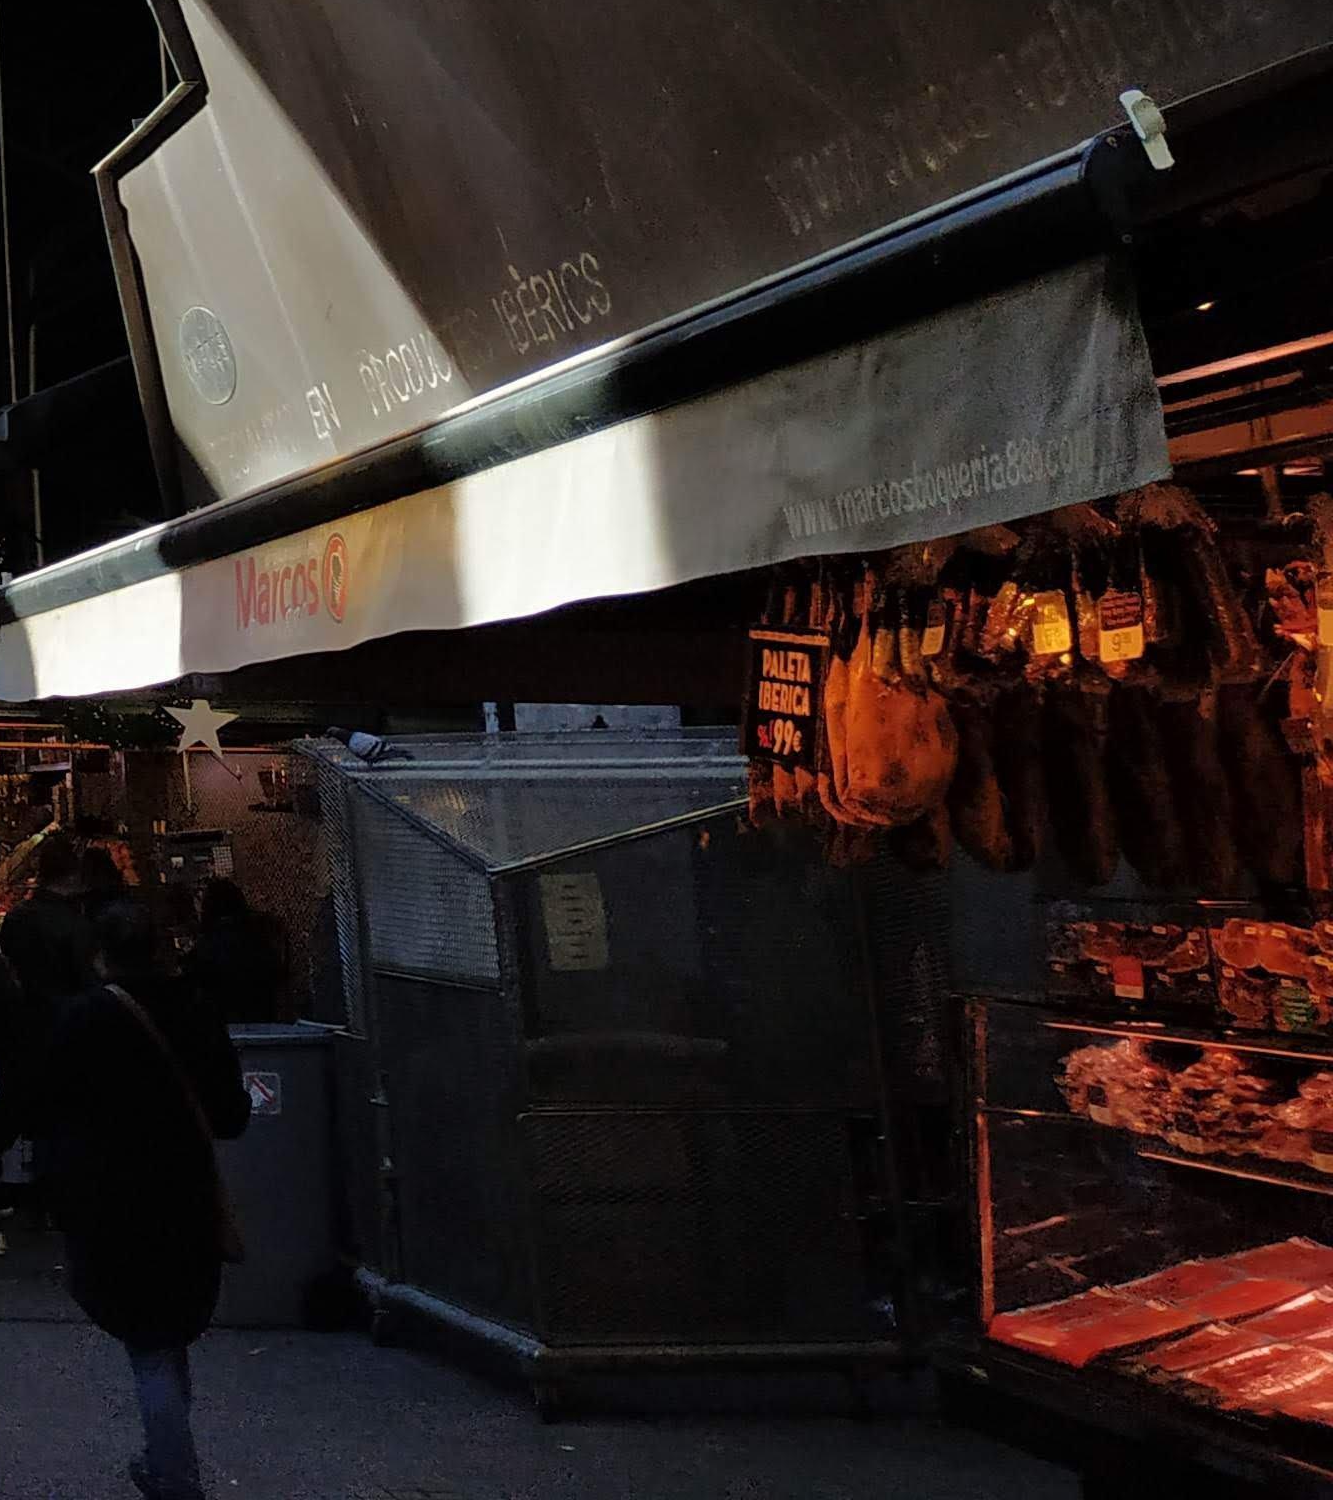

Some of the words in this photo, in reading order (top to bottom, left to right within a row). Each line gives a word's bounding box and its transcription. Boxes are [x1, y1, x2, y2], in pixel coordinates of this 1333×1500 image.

[304, 381, 342, 440] EN
[234, 556, 321, 631] Marcos
[762, 648, 811, 683] PALETA
[758, 681, 811, 717] IBERICA
